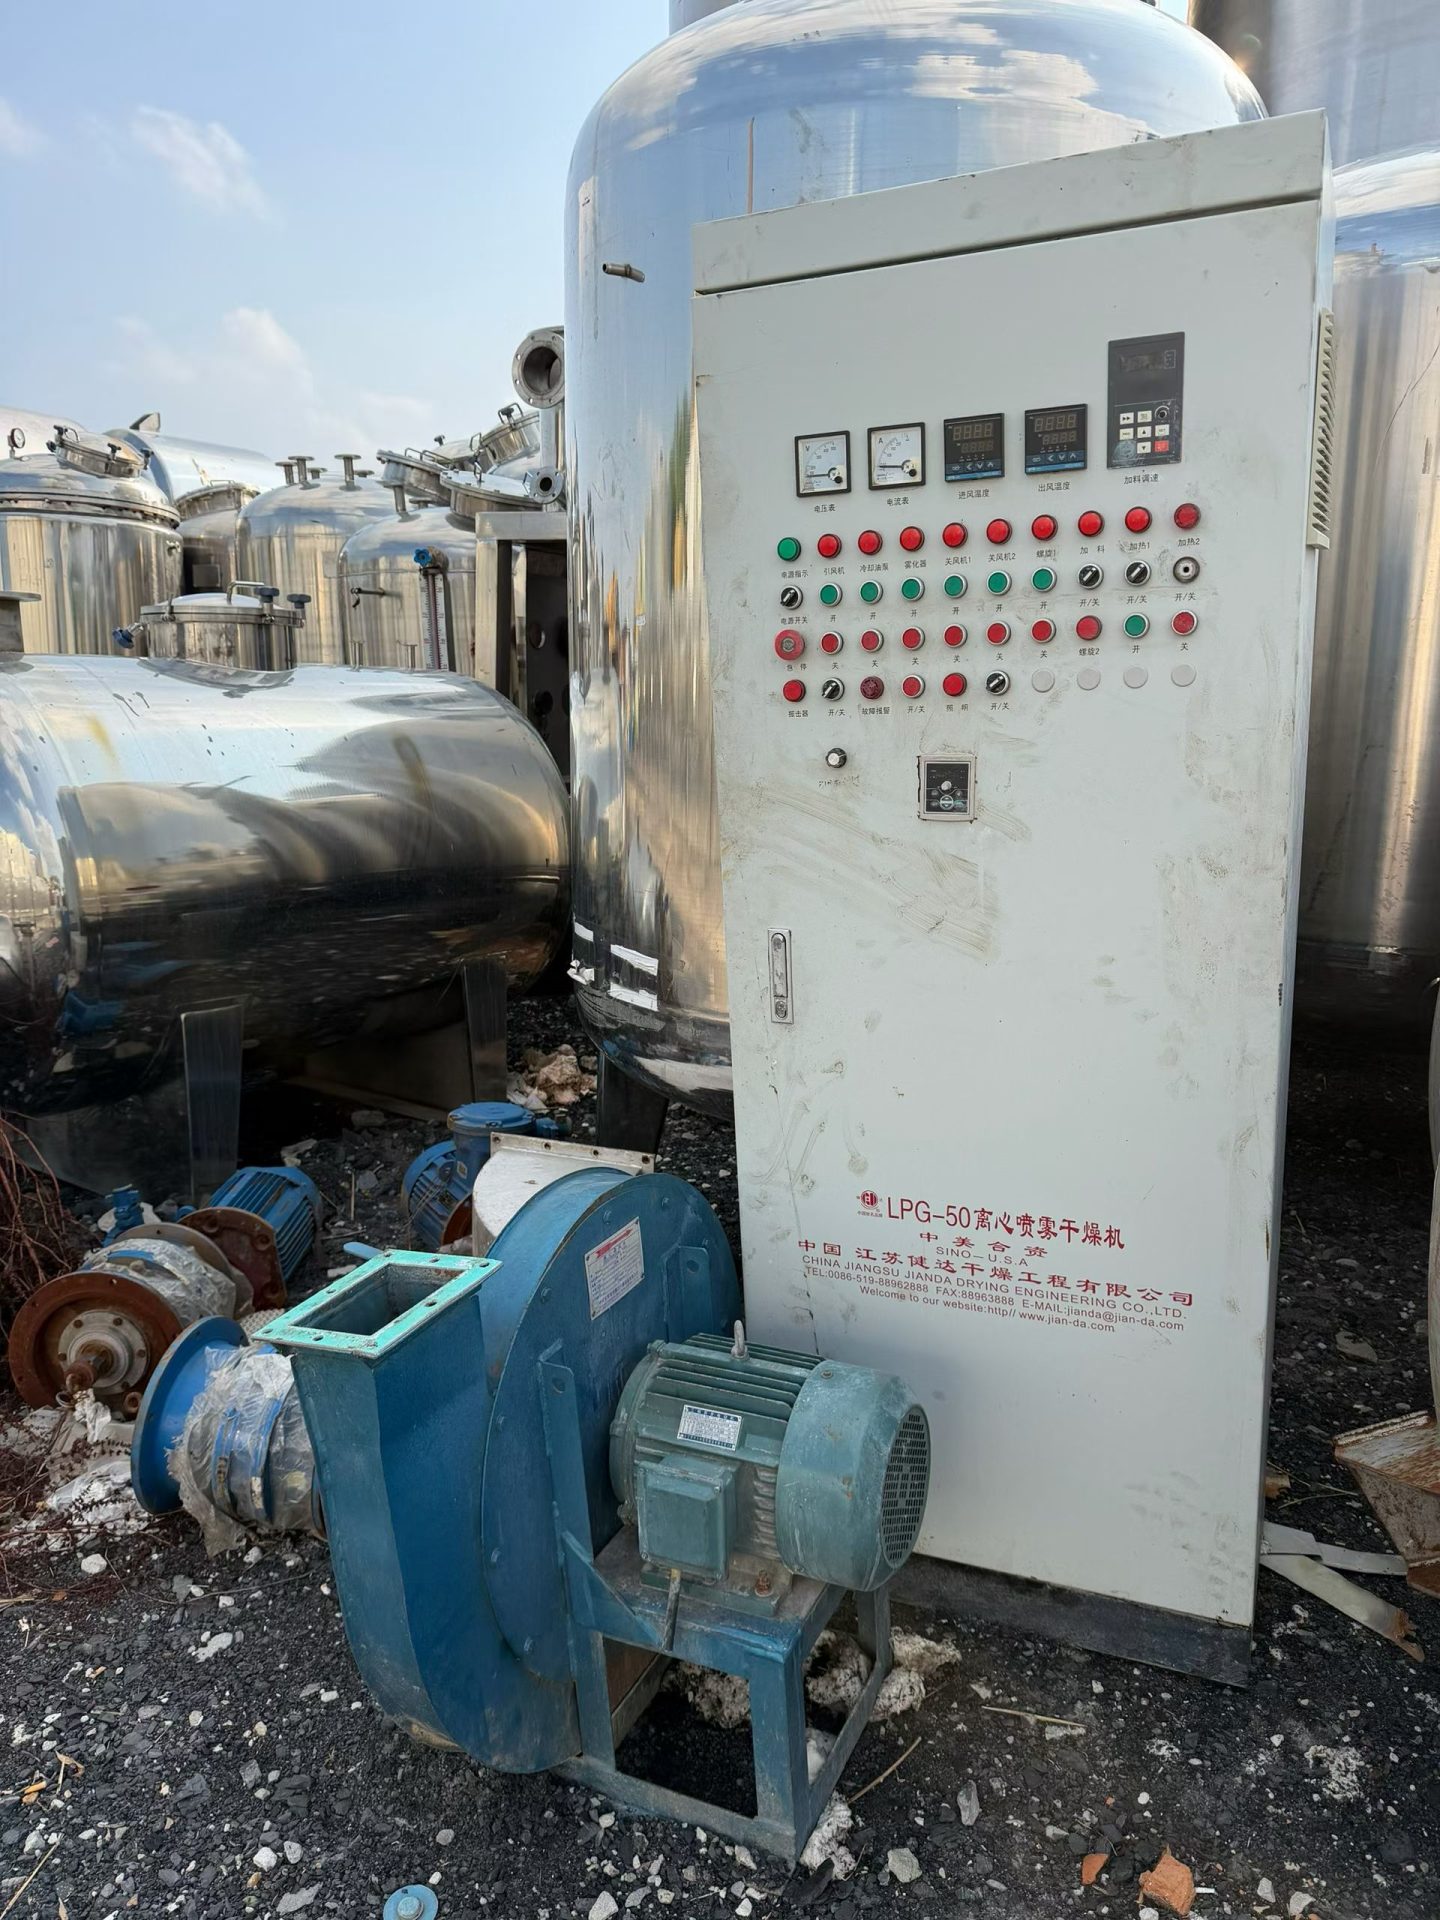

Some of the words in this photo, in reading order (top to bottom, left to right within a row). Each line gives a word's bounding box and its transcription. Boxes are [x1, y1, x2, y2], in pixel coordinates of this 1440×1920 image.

[1123, 473, 1159, 485] 加料调速
[1038, 481, 1071, 492] 出风温度
[958, 488, 990, 499] 进风温度
[886, 496, 909, 506] 电流表
[814, 503, 836, 513] 电压表
[1129, 542, 1150, 551] 加热1
[1178, 538, 1200, 547] 加热2
[860, 562, 889, 572] 冷却油泵
[904, 559, 927, 569] 雾化器
[781, 569, 808, 578] 电源指示
[823, 566, 845, 575] 引风机
[1126, 595, 1147, 604] 开/关
[1175, 592, 1196, 601] 开/关
[1040, 601, 1048, 610] 开
[1079, 598, 1100, 607] 开/关
[952, 607, 959, 615] 开
[996, 604, 1003, 612] 开
[870, 612, 876, 620] 开
[910, 609, 917, 617] 开
[780, 616, 808, 625] 电源开关
[1132, 645, 1140, 653] 开
[1180, 643, 1189, 651] 关
[996, 652, 1003, 660] 关
[1040, 650, 1048, 658] 关
[912, 657, 919, 665] 关
[953, 655, 960, 663] 关
[871, 660, 878, 668] 关
[861, 706, 890, 715] 故障报警
[907, 705, 925, 714] 开/关
[990, 702, 1010, 711] 开/关
[919, 1232, 1048, 1258] 中美合资
[798, 1239, 841, 1256] 中国
[855, 1247, 1193, 1306] 江苏健达干燥工程有限公司
[802, 1255, 841, 1268] CHINA
[844, 1261, 900, 1277] JIANGSU
[904, 1269, 952, 1286] JIANDA
[956, 1277, 1009, 1294] DRYING
[1015, 1286, 1117, 1309] ENGINEERING
[805, 1266, 929, 1293] TEL:0086-519-88962888
[936, 1286, 1015, 1306] FAX:88963888
[1022, 1299, 1184, 1331] E-MAIL:jianda@jian-da.com
[859, 1285, 906, 1300] Welcome
[909, 1294, 919, 1303] to
[922, 1297, 939, 1306] our
[1019, 1311, 1115, 1332] www.jian-da.com
